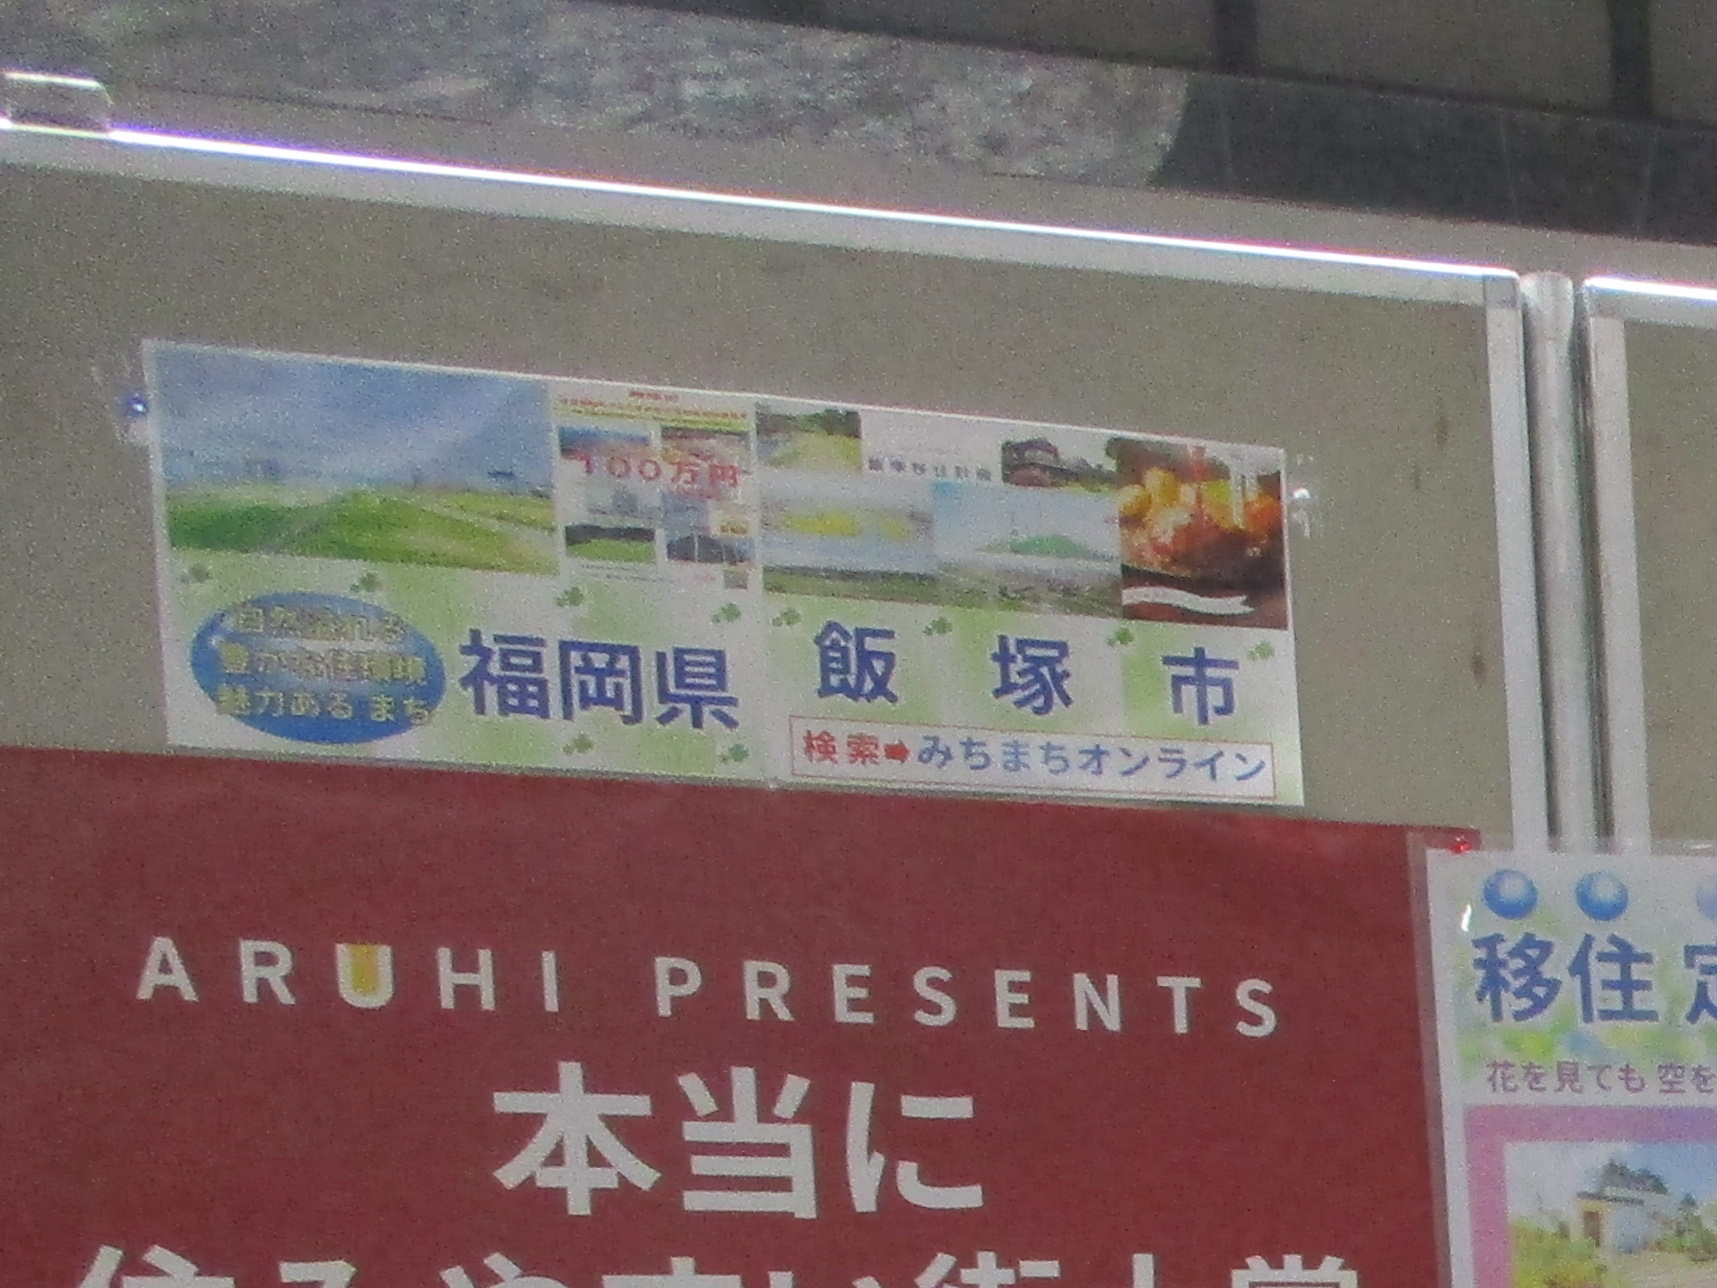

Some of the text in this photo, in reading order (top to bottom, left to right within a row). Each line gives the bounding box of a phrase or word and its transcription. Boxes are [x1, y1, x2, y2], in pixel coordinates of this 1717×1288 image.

[457, 618, 1240, 731] 福岡県 飯塚市
[802, 727, 1266, 781] 検索 みちまちオンライン
[136, 936, 1281, 1040] ARUHI PRESENTS
[492, 1060, 985, 1220] 本当に
